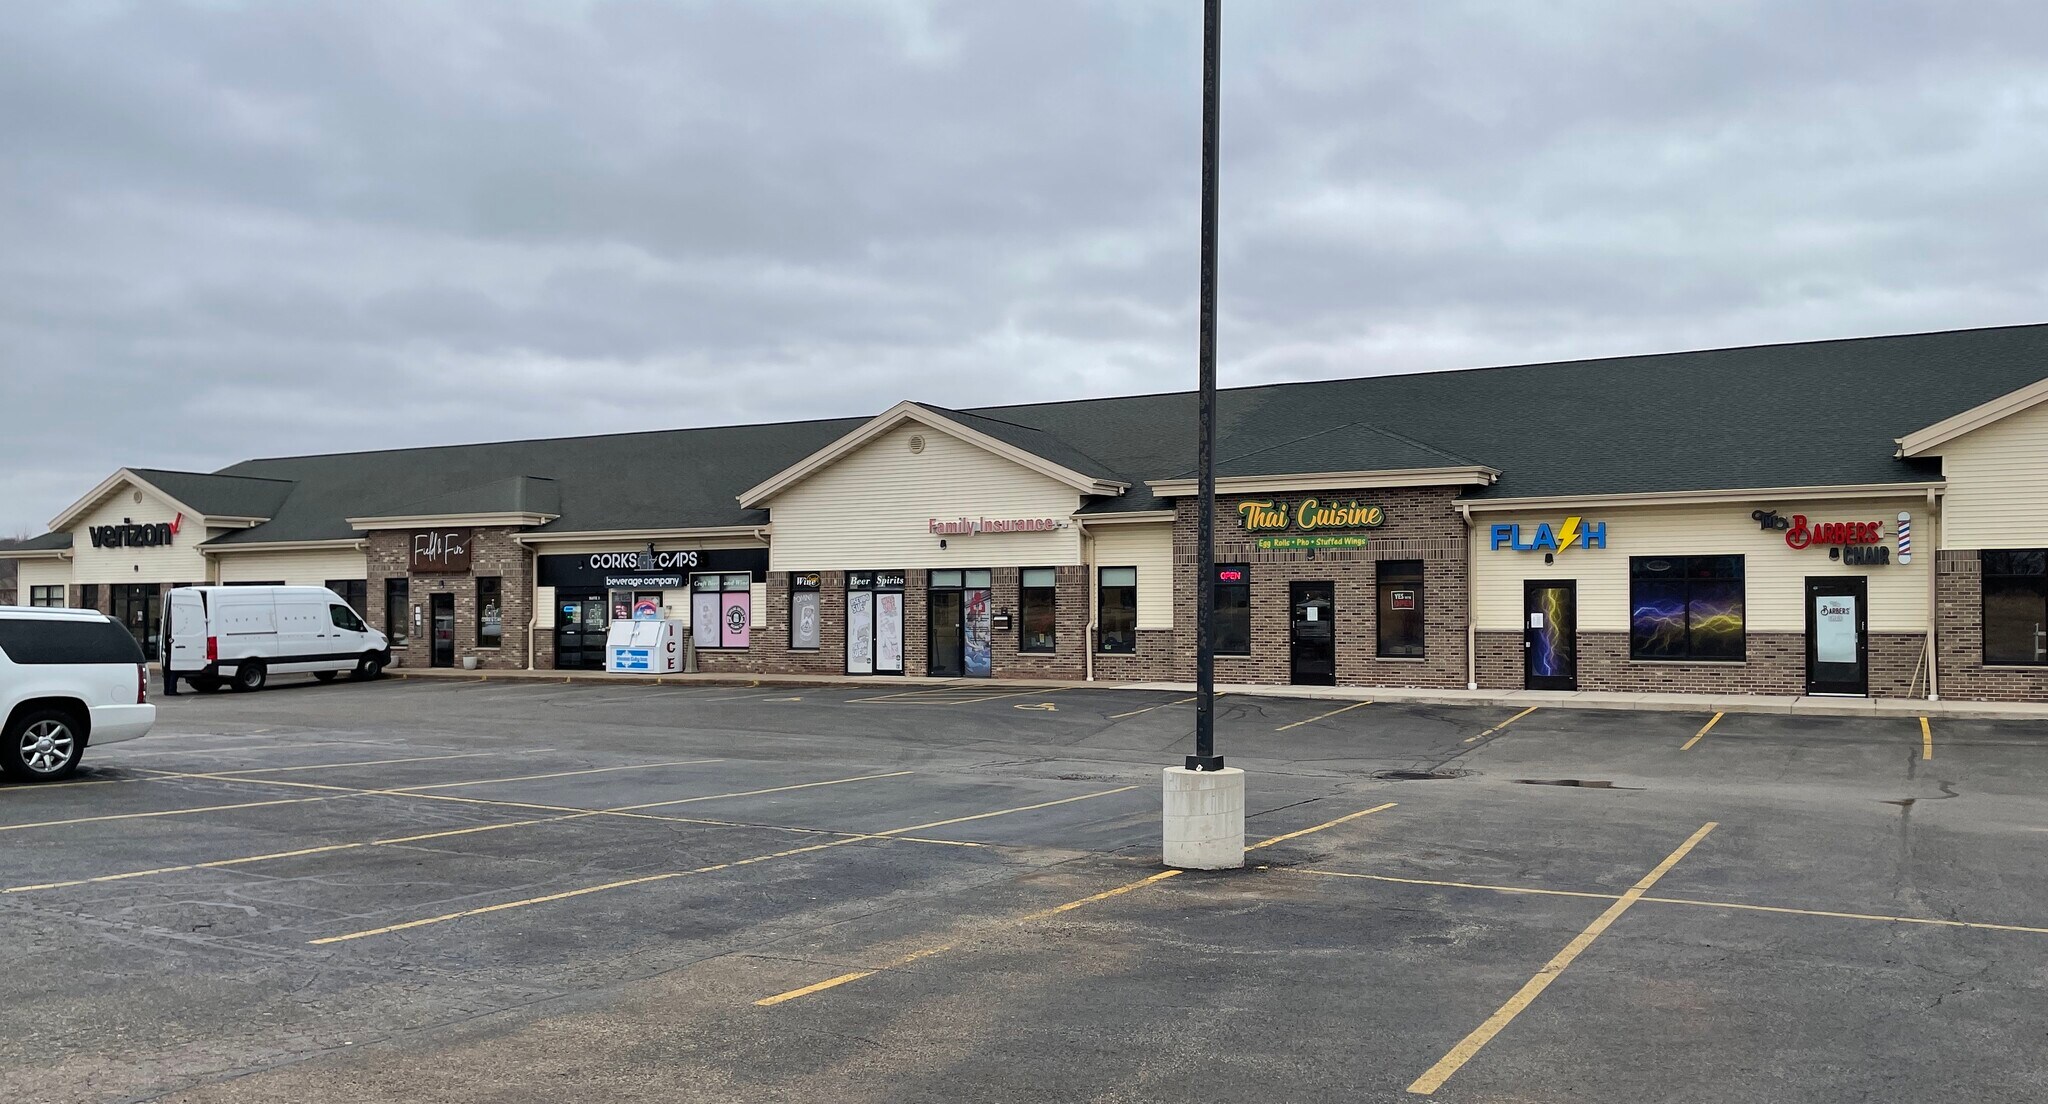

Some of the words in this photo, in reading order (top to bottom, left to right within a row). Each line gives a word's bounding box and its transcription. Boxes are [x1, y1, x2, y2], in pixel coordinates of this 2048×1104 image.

[1239, 501, 1288, 529] Thai
[1298, 499, 1382, 529] Cuisine
[89, 517, 172, 548] verizon
[929, 517, 975, 536] Family
[980, 516, 1054, 532] Insurance
[414, 531, 438, 565] Field
[445, 533, 465, 565] Fire
[1258, 539, 1271, 548] Egg
[1273, 538, 1290, 547] Rolls
[1296, 538, 1310, 546] Pho
[1316, 537, 1343, 546] Stuffed
[1344, 537, 1366, 546] Wings
[590, 553, 637, 569] CORKS
[658, 551, 698, 568] CAPS
[1843, 546, 1890, 565] CHAIR
[606, 576, 643, 587] beverage
[643, 577, 680, 586] company
[796, 576, 817, 586] Wine
[850, 576, 871, 586] Beer
[876, 575, 904, 587] Spirits
[1220, 571, 1241, 580] OPEN
[666, 623, 676, 670] ICE
